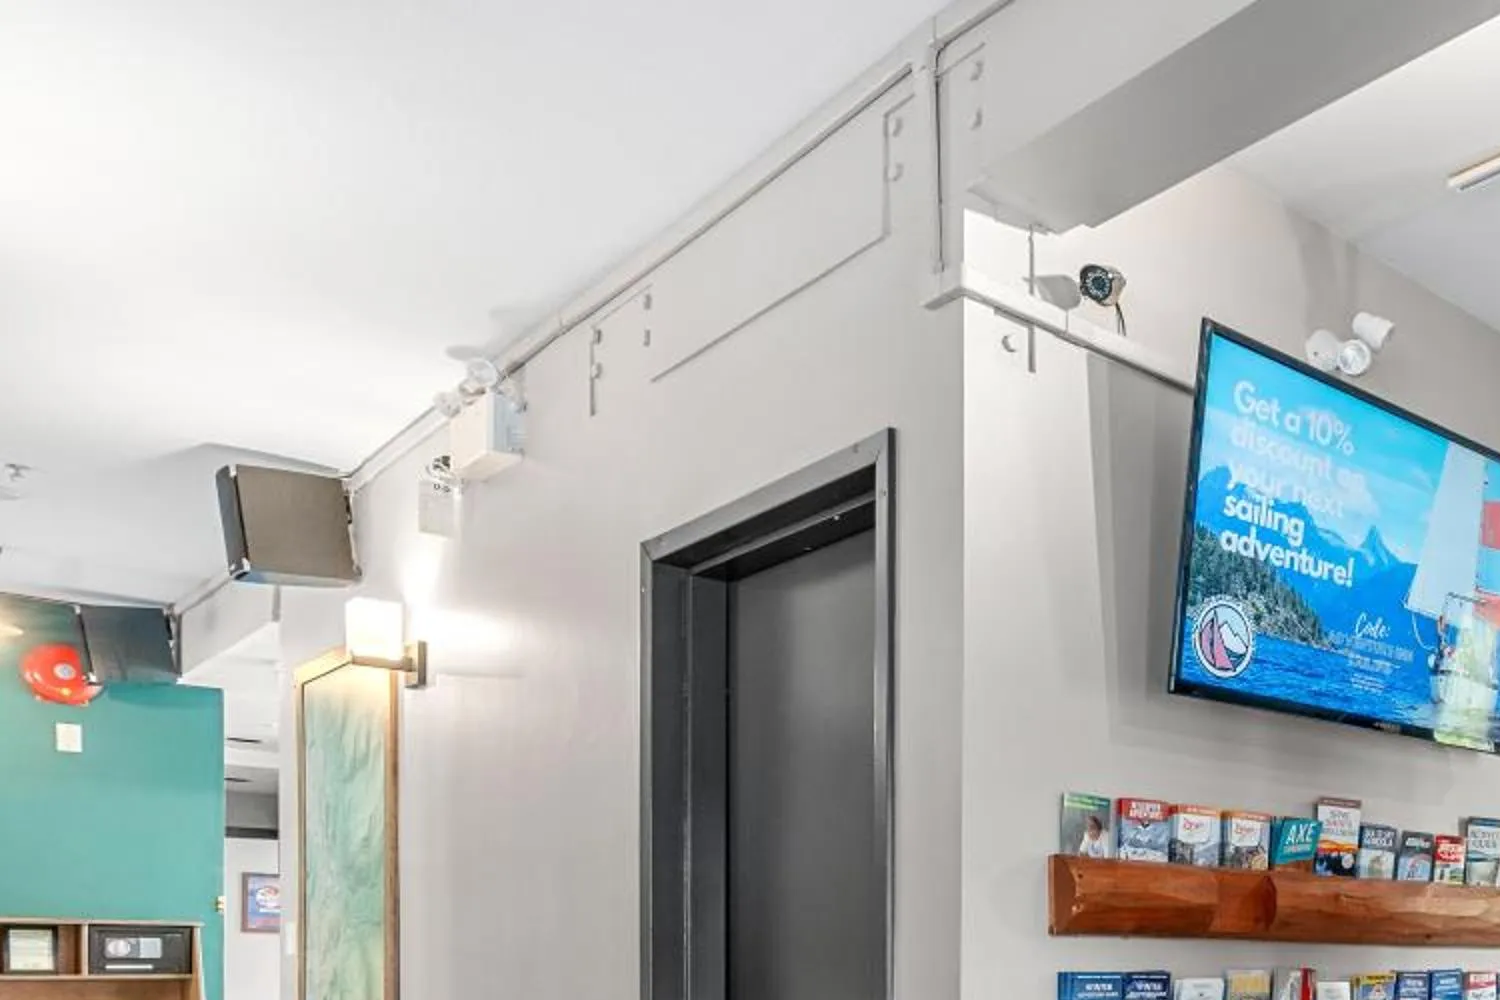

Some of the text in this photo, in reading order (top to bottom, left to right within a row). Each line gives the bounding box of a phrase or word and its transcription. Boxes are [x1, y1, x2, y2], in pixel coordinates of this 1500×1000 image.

[1233, 380, 1354, 456] Get a 10%
[1226, 460, 1284, 497] your
[1231, 421, 1332, 480] discount
[1223, 493, 1305, 547] sailing
[1220, 525, 1355, 588] adventure!
[1285, 823, 1319, 845] AXE
